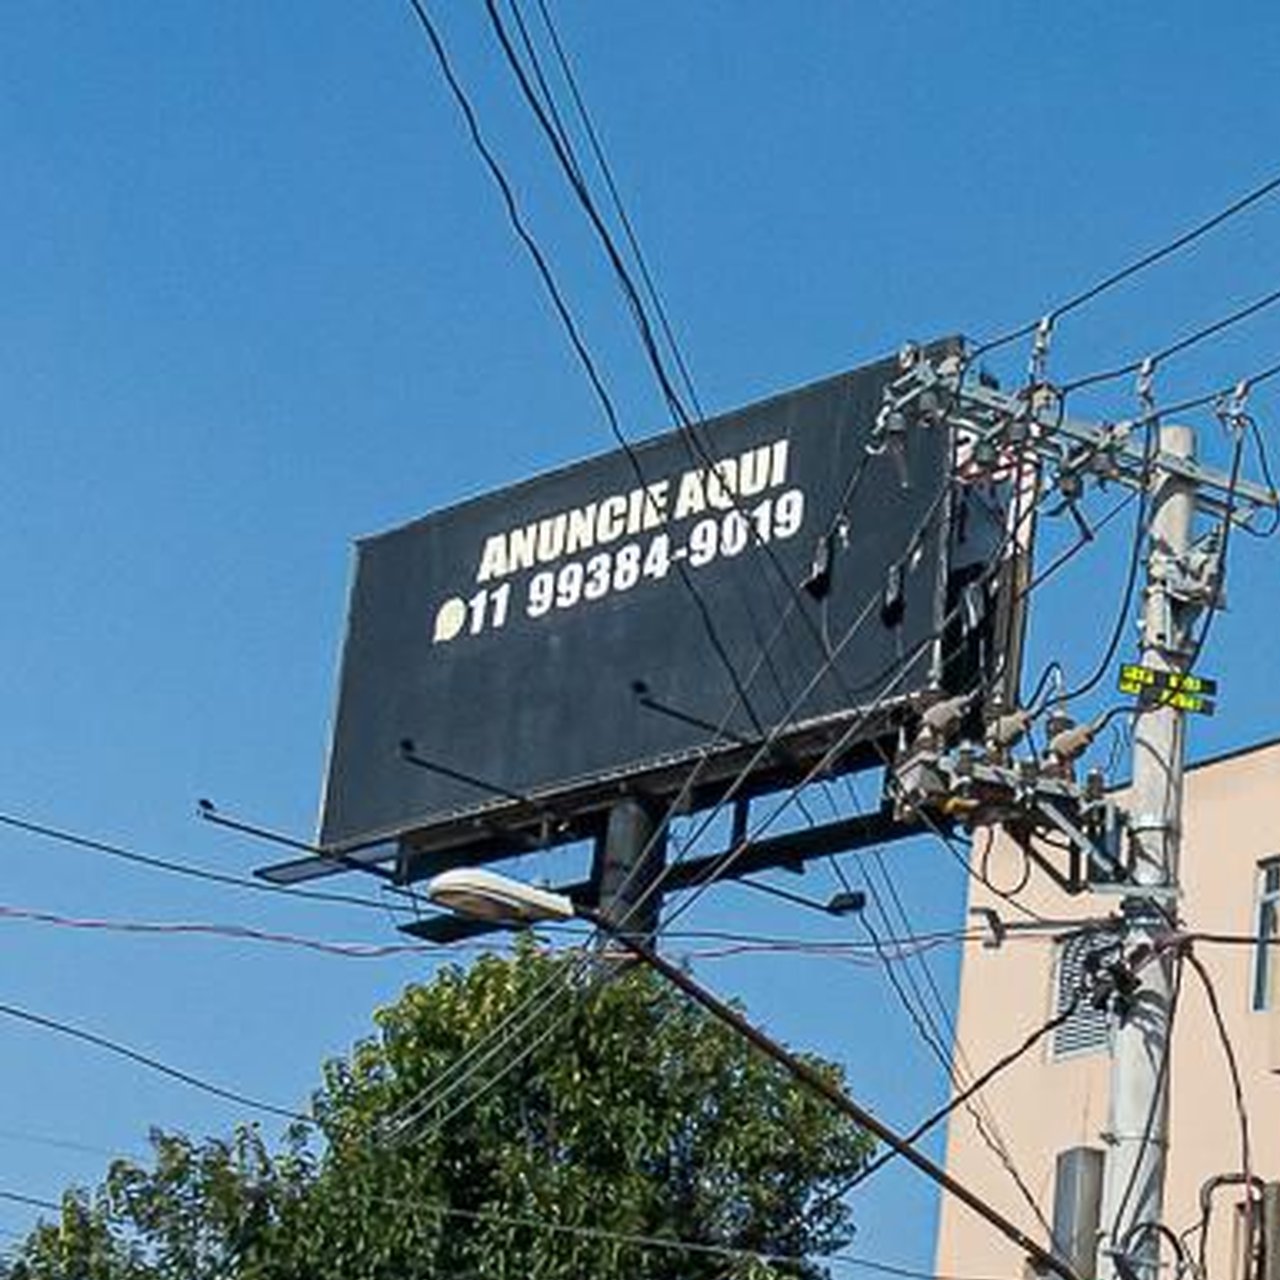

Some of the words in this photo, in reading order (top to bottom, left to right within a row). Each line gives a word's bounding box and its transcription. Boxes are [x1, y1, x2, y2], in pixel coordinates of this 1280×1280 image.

[469, 584, 511, 633] 11
[526, 489, 804, 617] 99384-9019
[477, 483, 668, 582] ANUNCIE
[674, 440, 788, 520] AQUI
